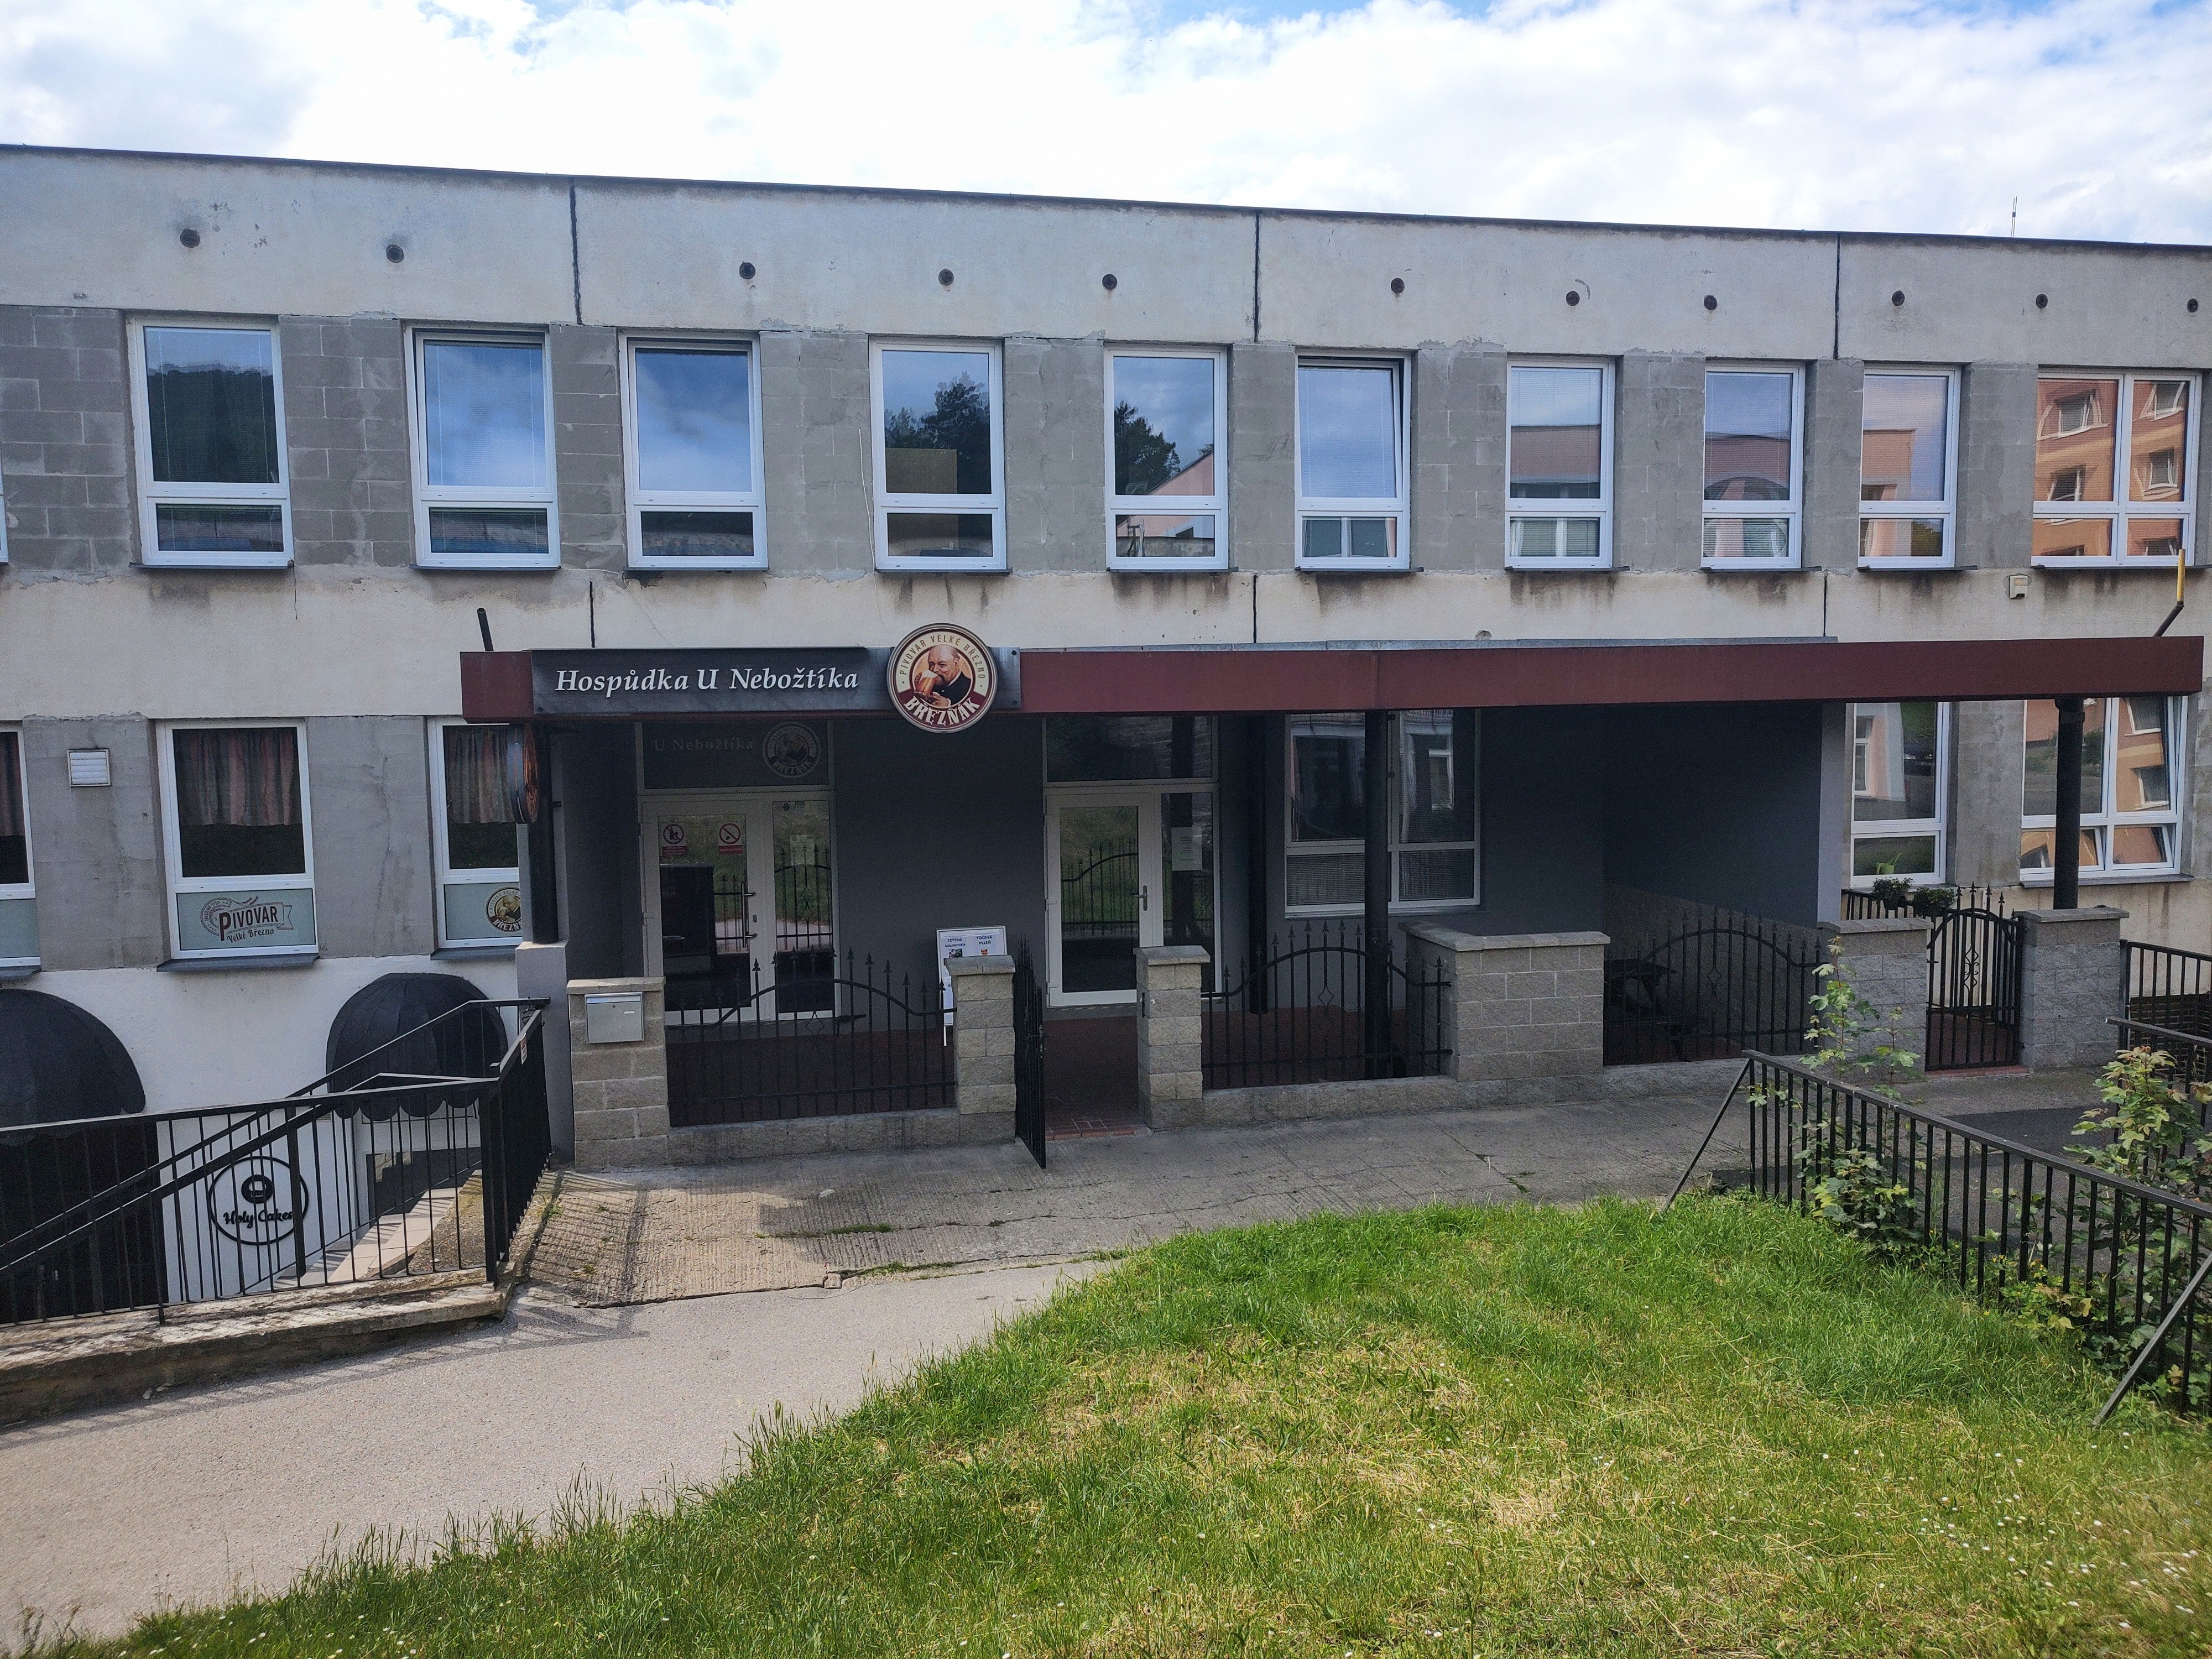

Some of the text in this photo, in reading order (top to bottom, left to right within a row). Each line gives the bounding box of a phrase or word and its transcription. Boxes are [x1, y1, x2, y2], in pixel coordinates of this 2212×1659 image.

[899, 634, 986, 679] PIVOVAR VELKÉ BŘEZNO
[555, 667, 859, 698] Hospůdka U Nebožtíka
[904, 696, 980, 726] BŘEZŇÁK
[654, 738, 665, 751] U
[672, 737, 754, 750] Nebožtíka
[219, 906, 279, 941] PIVOVAR
[227, 928, 275, 943] Velké Březno
[223, 1208, 294, 1229] Holy Cakes
